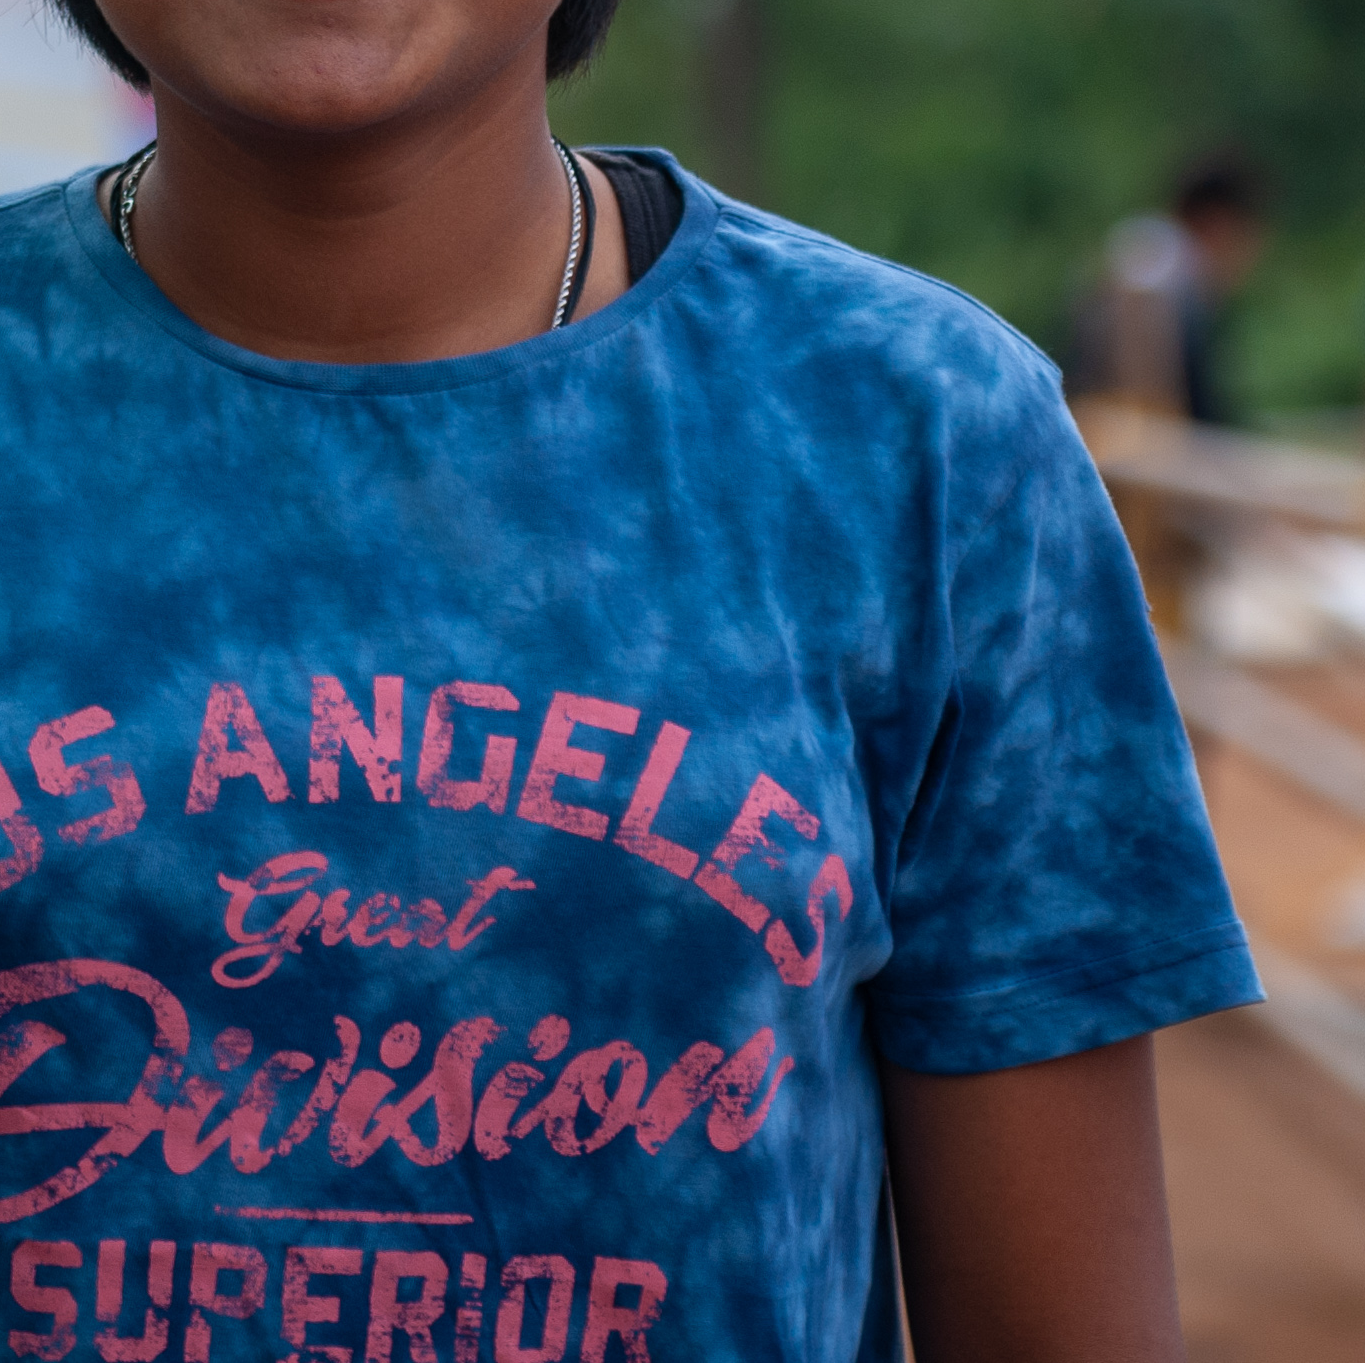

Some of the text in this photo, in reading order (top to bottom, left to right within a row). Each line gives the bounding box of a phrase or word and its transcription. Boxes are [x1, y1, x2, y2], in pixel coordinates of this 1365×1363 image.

[186, 675, 854, 988] ANGELES
[211, 850, 536, 988] Great
[9, 1239, 668, 1363] SUPERIOR
